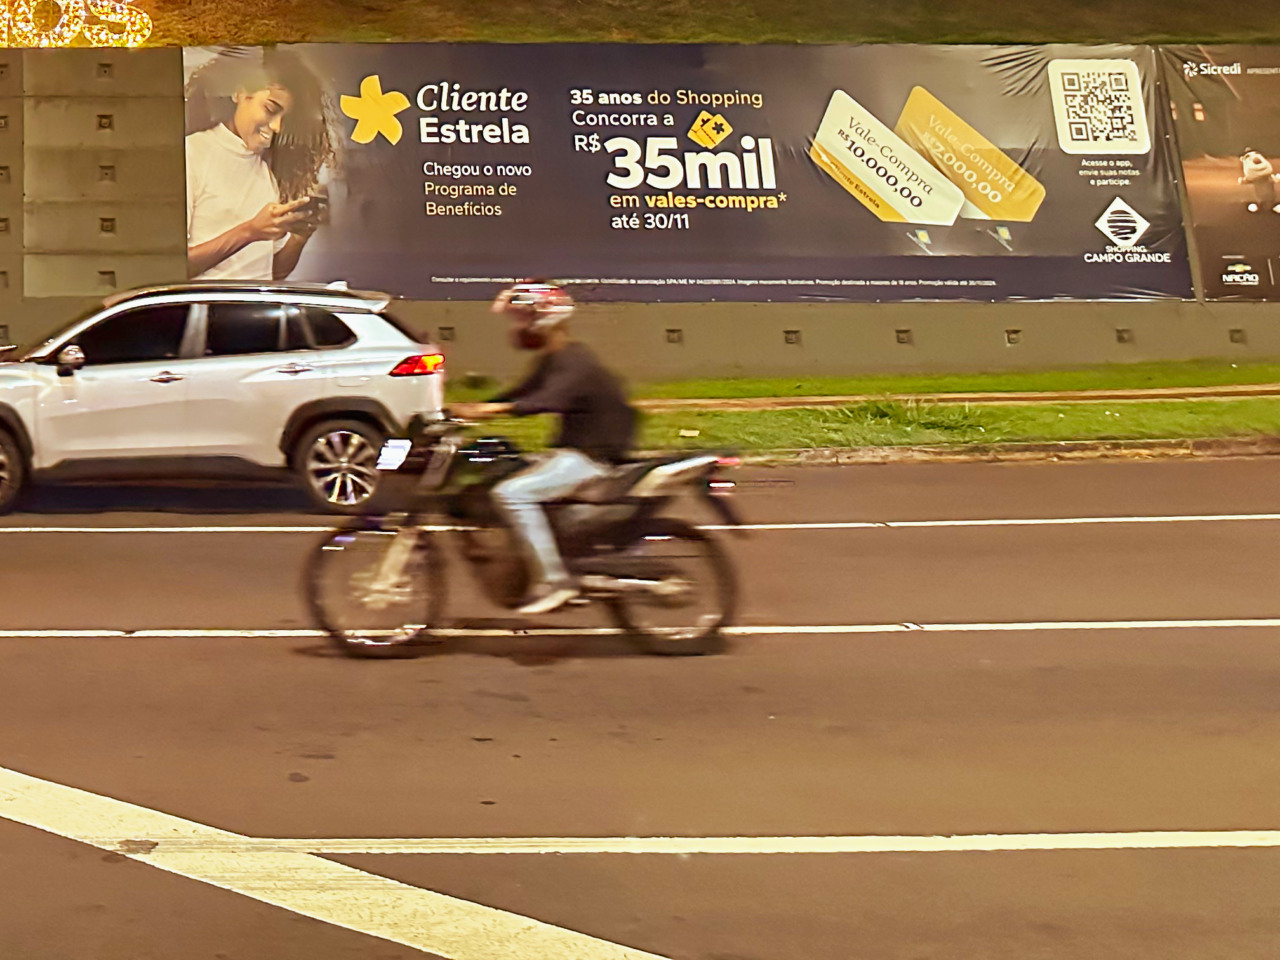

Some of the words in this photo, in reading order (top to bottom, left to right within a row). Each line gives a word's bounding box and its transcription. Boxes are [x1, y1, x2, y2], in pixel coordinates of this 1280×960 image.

[1200, 63, 1241, 74] Sicredi
[416, 81, 528, 112] Cliente
[570, 89, 594, 105] 35
[598, 91, 642, 105] anos
[647, 89, 671, 105] do
[676, 89, 764, 108] Shopping
[572, 110, 658, 126] Concorra
[663, 114, 674, 126] a
[420, 117, 530, 144] Estrela
[848, 116, 934, 196] Vale-Compra
[928, 114, 1016, 193] Vale-Compra
[423, 161, 480, 179] Chegou
[483, 164, 493, 176] o
[496, 164, 532, 176] novo
[1081, 159, 1108, 167] Acesse
[424, 181, 495, 199] Programa
[498, 182, 517, 196] de
[425, 201, 503, 216] Benefícios
[610, 195, 639, 207] em
[611, 213, 640, 229] até
[644, 213, 690, 229] 30/11
[1084, 253, 1123, 263] CAMPO
[1125, 253, 1172, 263] GRANDE
